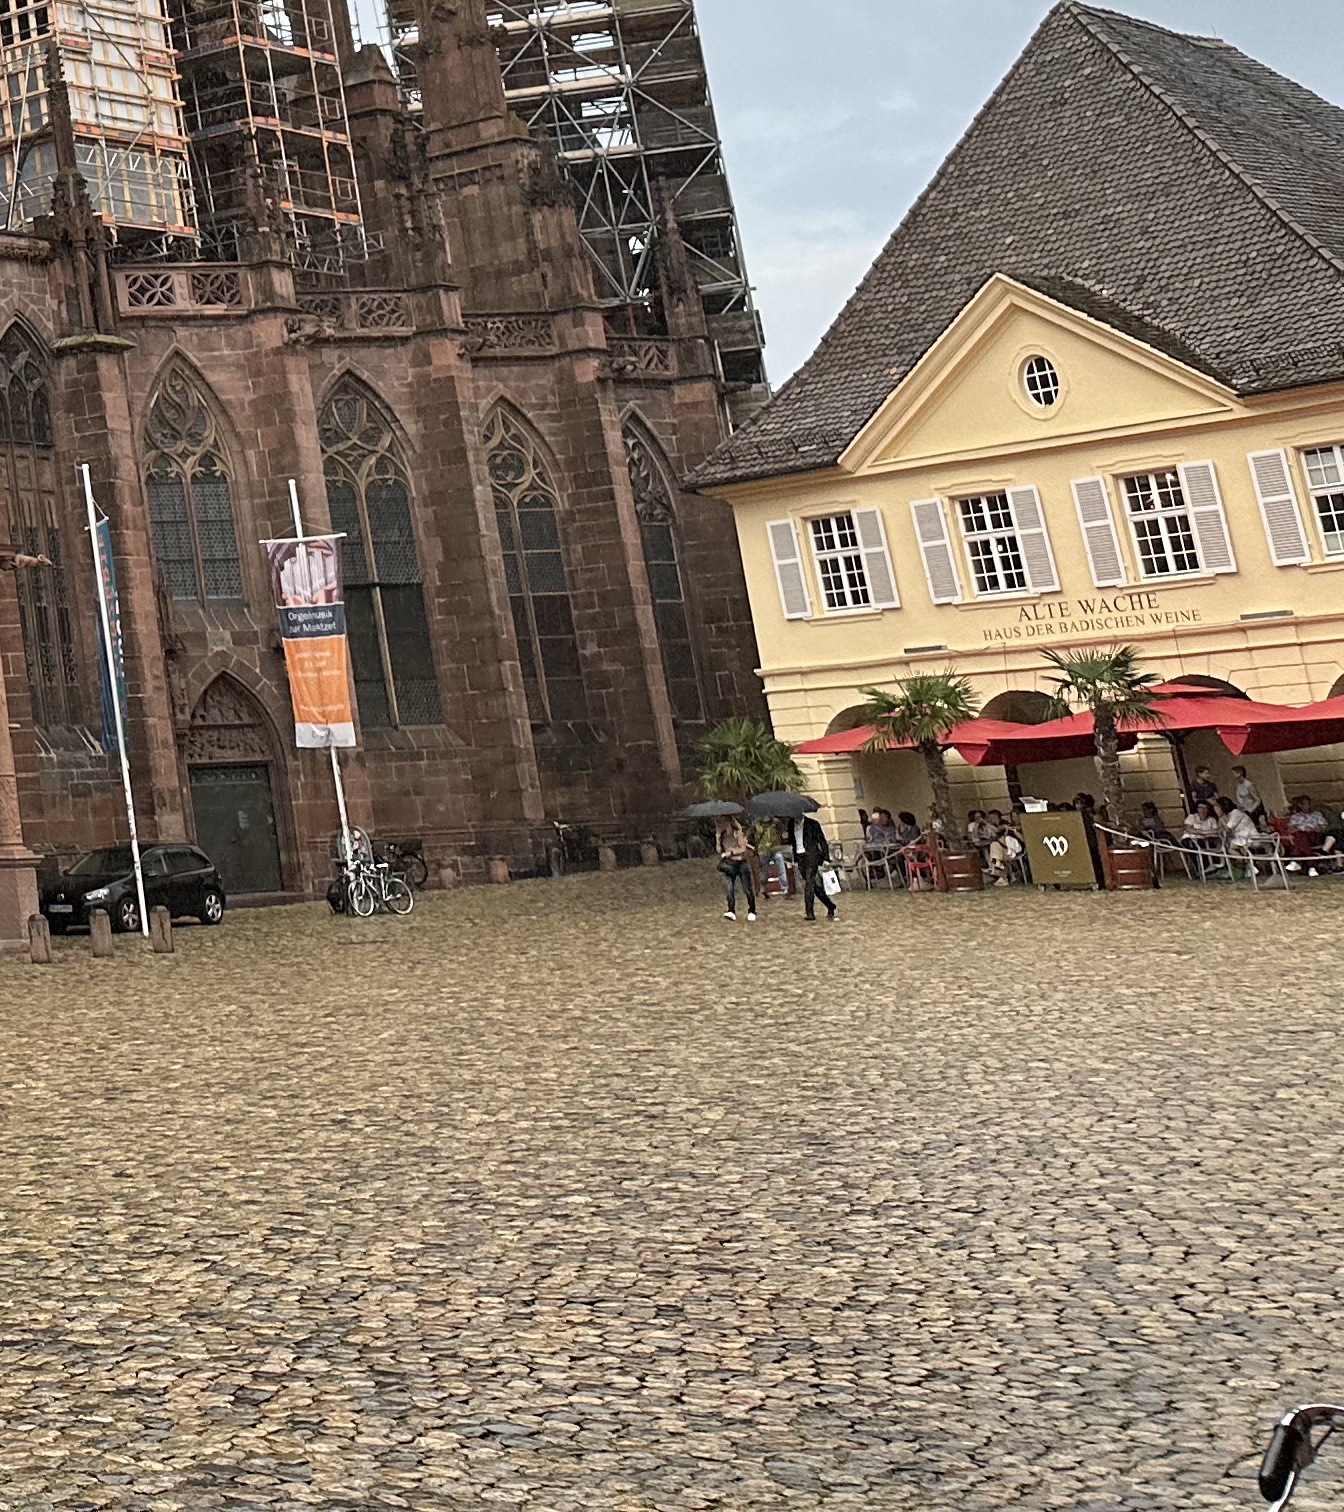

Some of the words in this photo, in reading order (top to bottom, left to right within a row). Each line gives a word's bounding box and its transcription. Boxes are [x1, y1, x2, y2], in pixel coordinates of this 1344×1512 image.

[1018, 601, 1071, 622] ALTE
[1078, 592, 1160, 615] WACHE
[983, 625, 1022, 641] HAUS
[1026, 623, 1055, 637] DER
[1059, 613, 1146, 634] BADISCHEN
[1150, 609, 1202, 624] WEINE
